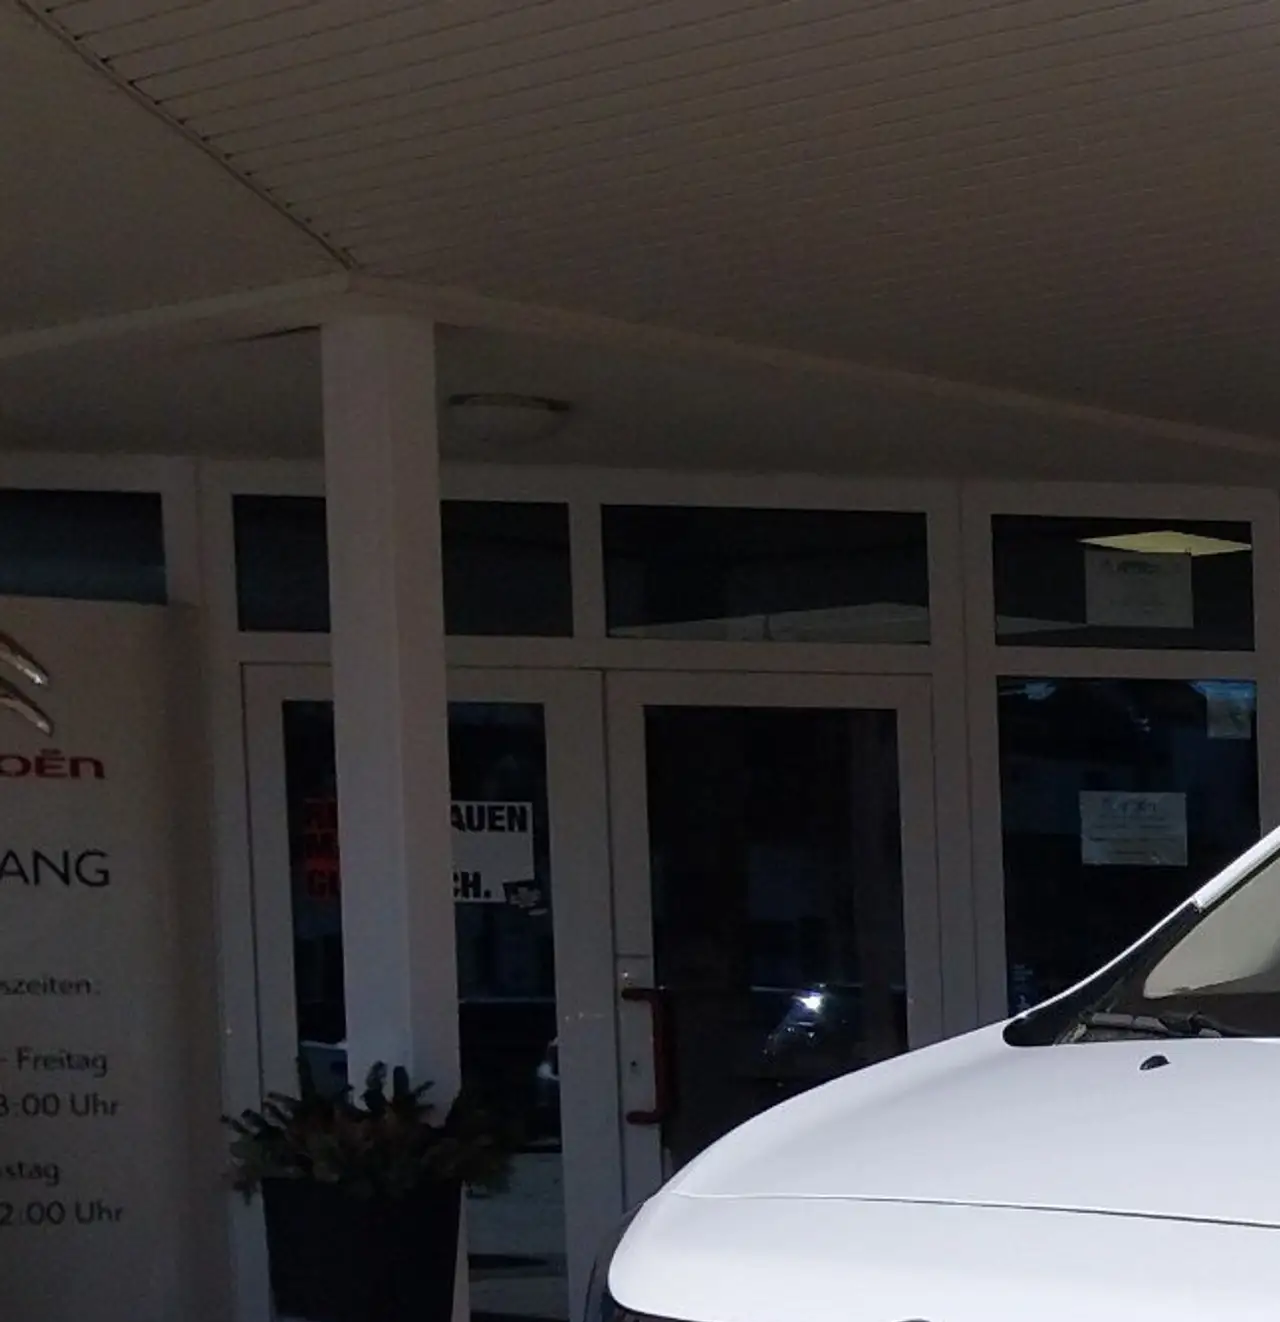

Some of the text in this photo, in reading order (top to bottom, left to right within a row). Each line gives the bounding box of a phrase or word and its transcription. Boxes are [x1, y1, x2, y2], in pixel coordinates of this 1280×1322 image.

[0, 849, 110, 887] ANG
[16, 1046, 108, 1078] Freitag
[69, 1091, 120, 1118] Uhr
[75, 1199, 124, 1225] Uhr
